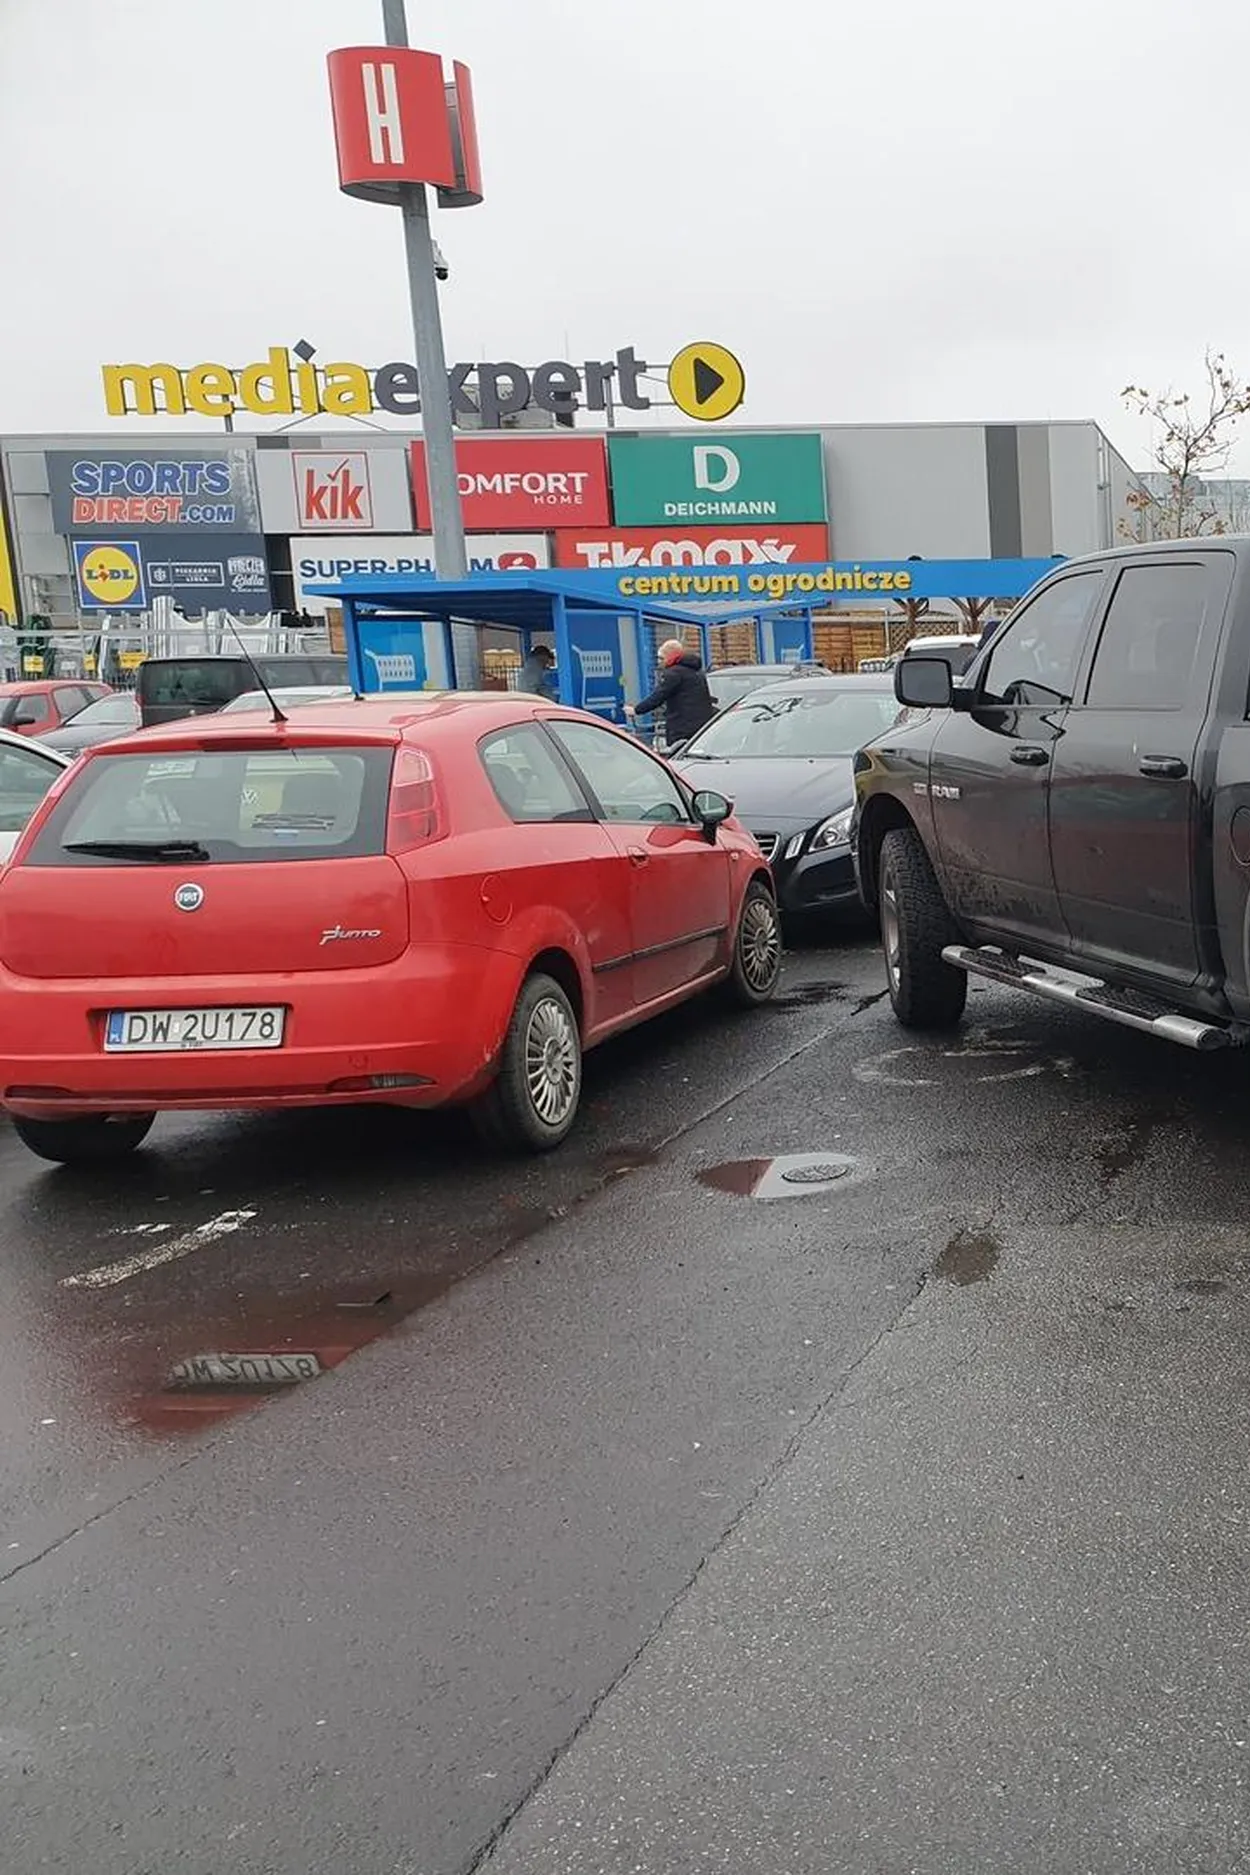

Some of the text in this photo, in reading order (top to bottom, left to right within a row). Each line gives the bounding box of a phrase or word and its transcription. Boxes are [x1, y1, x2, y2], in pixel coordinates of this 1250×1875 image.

[361, 63, 405, 165] H
[71, 461, 231, 496] SPORTS
[303, 459, 364, 520] kik
[456, 472, 588, 495] OMFORT
[534, 495, 583, 504] HOME
[664, 501, 777, 517] DEICHMANN
[618, 564, 912, 598] centrum ogrodnicze
[128, 1011, 275, 1043] DW 2U178
